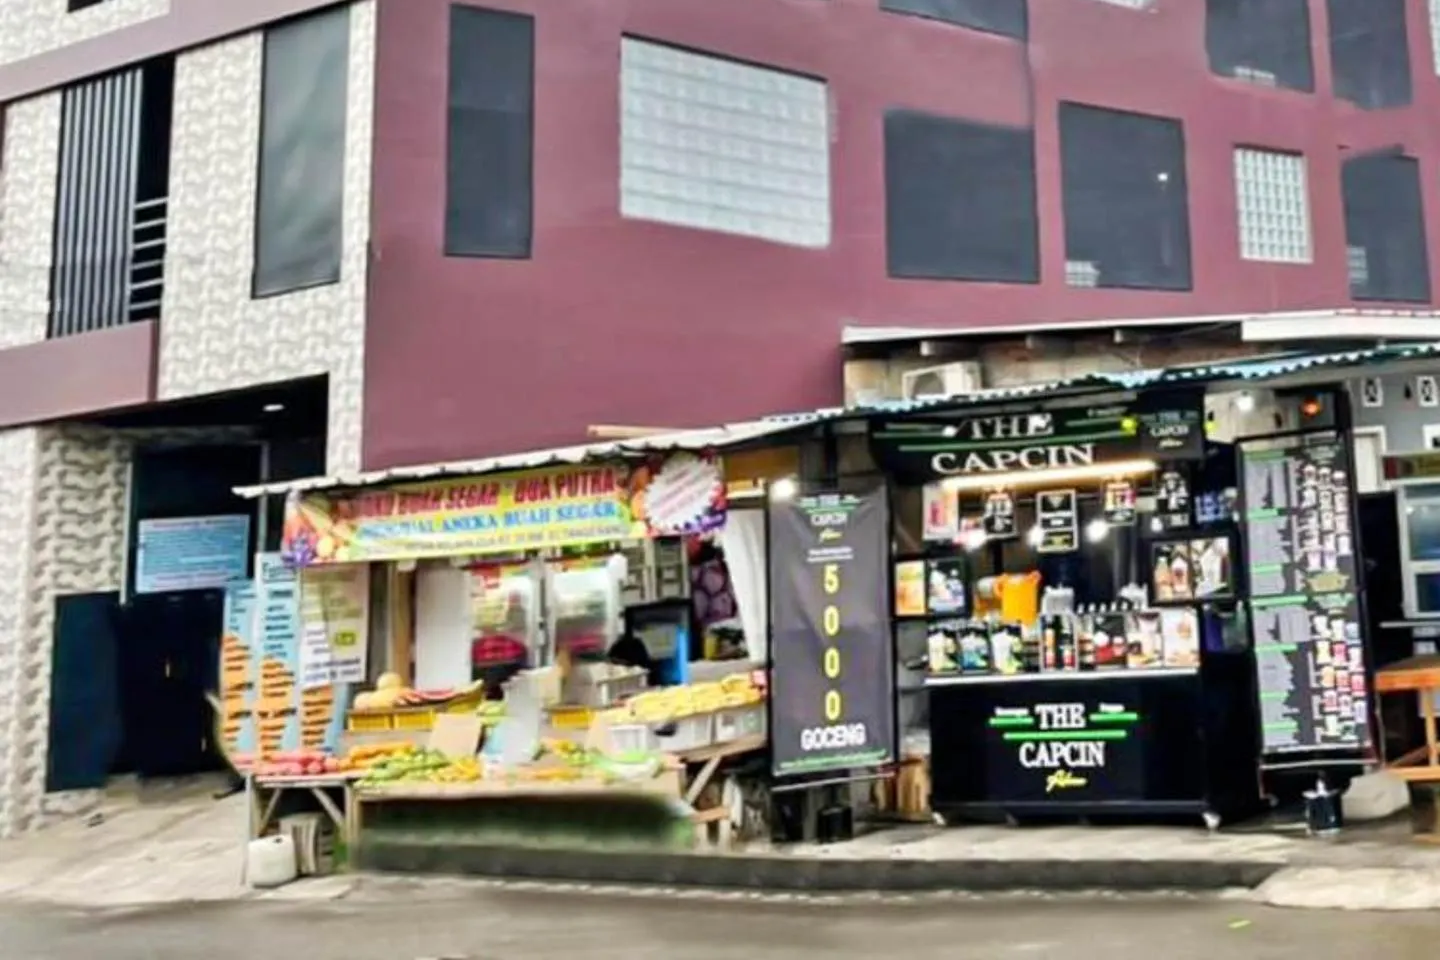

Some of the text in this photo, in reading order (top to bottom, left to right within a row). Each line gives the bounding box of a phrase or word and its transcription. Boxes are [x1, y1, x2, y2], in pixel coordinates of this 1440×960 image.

[969, 413, 1054, 440] THE
[931, 443, 1097, 475] CAPCIN
[556, 466, 616, 499] PUTRA
[1034, 702, 1087, 730] THE
[801, 723, 867, 751] GOCENG
[1018, 741, 1107, 768] CAPCIN
